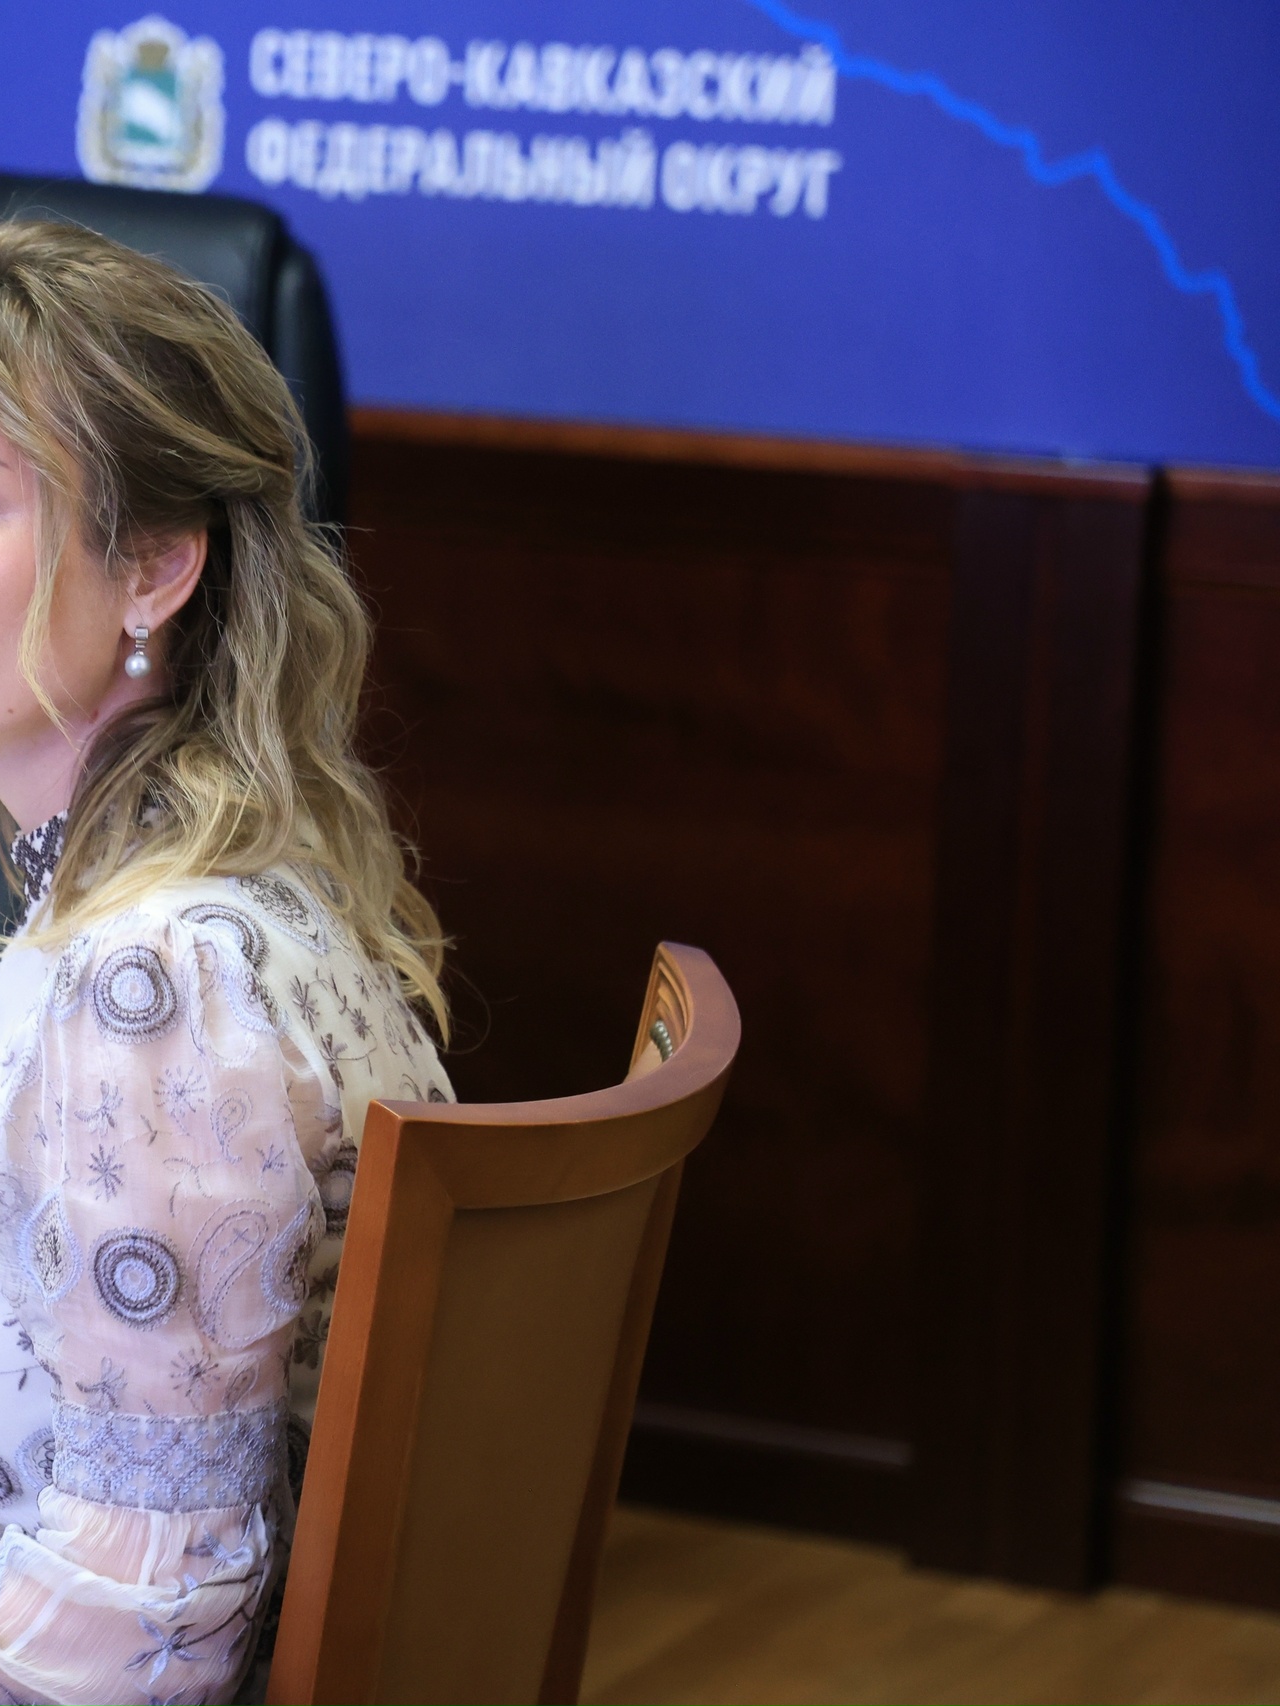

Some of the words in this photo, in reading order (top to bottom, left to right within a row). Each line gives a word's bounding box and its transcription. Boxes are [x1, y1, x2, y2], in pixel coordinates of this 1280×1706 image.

[250, 28, 838, 125] СЕВЕРО-КАВКАЗСКИЙ
[246, 119, 657, 208] ФЕДЕРАЛЬНЫЙ
[660, 141, 842, 219] ОКРУГ
